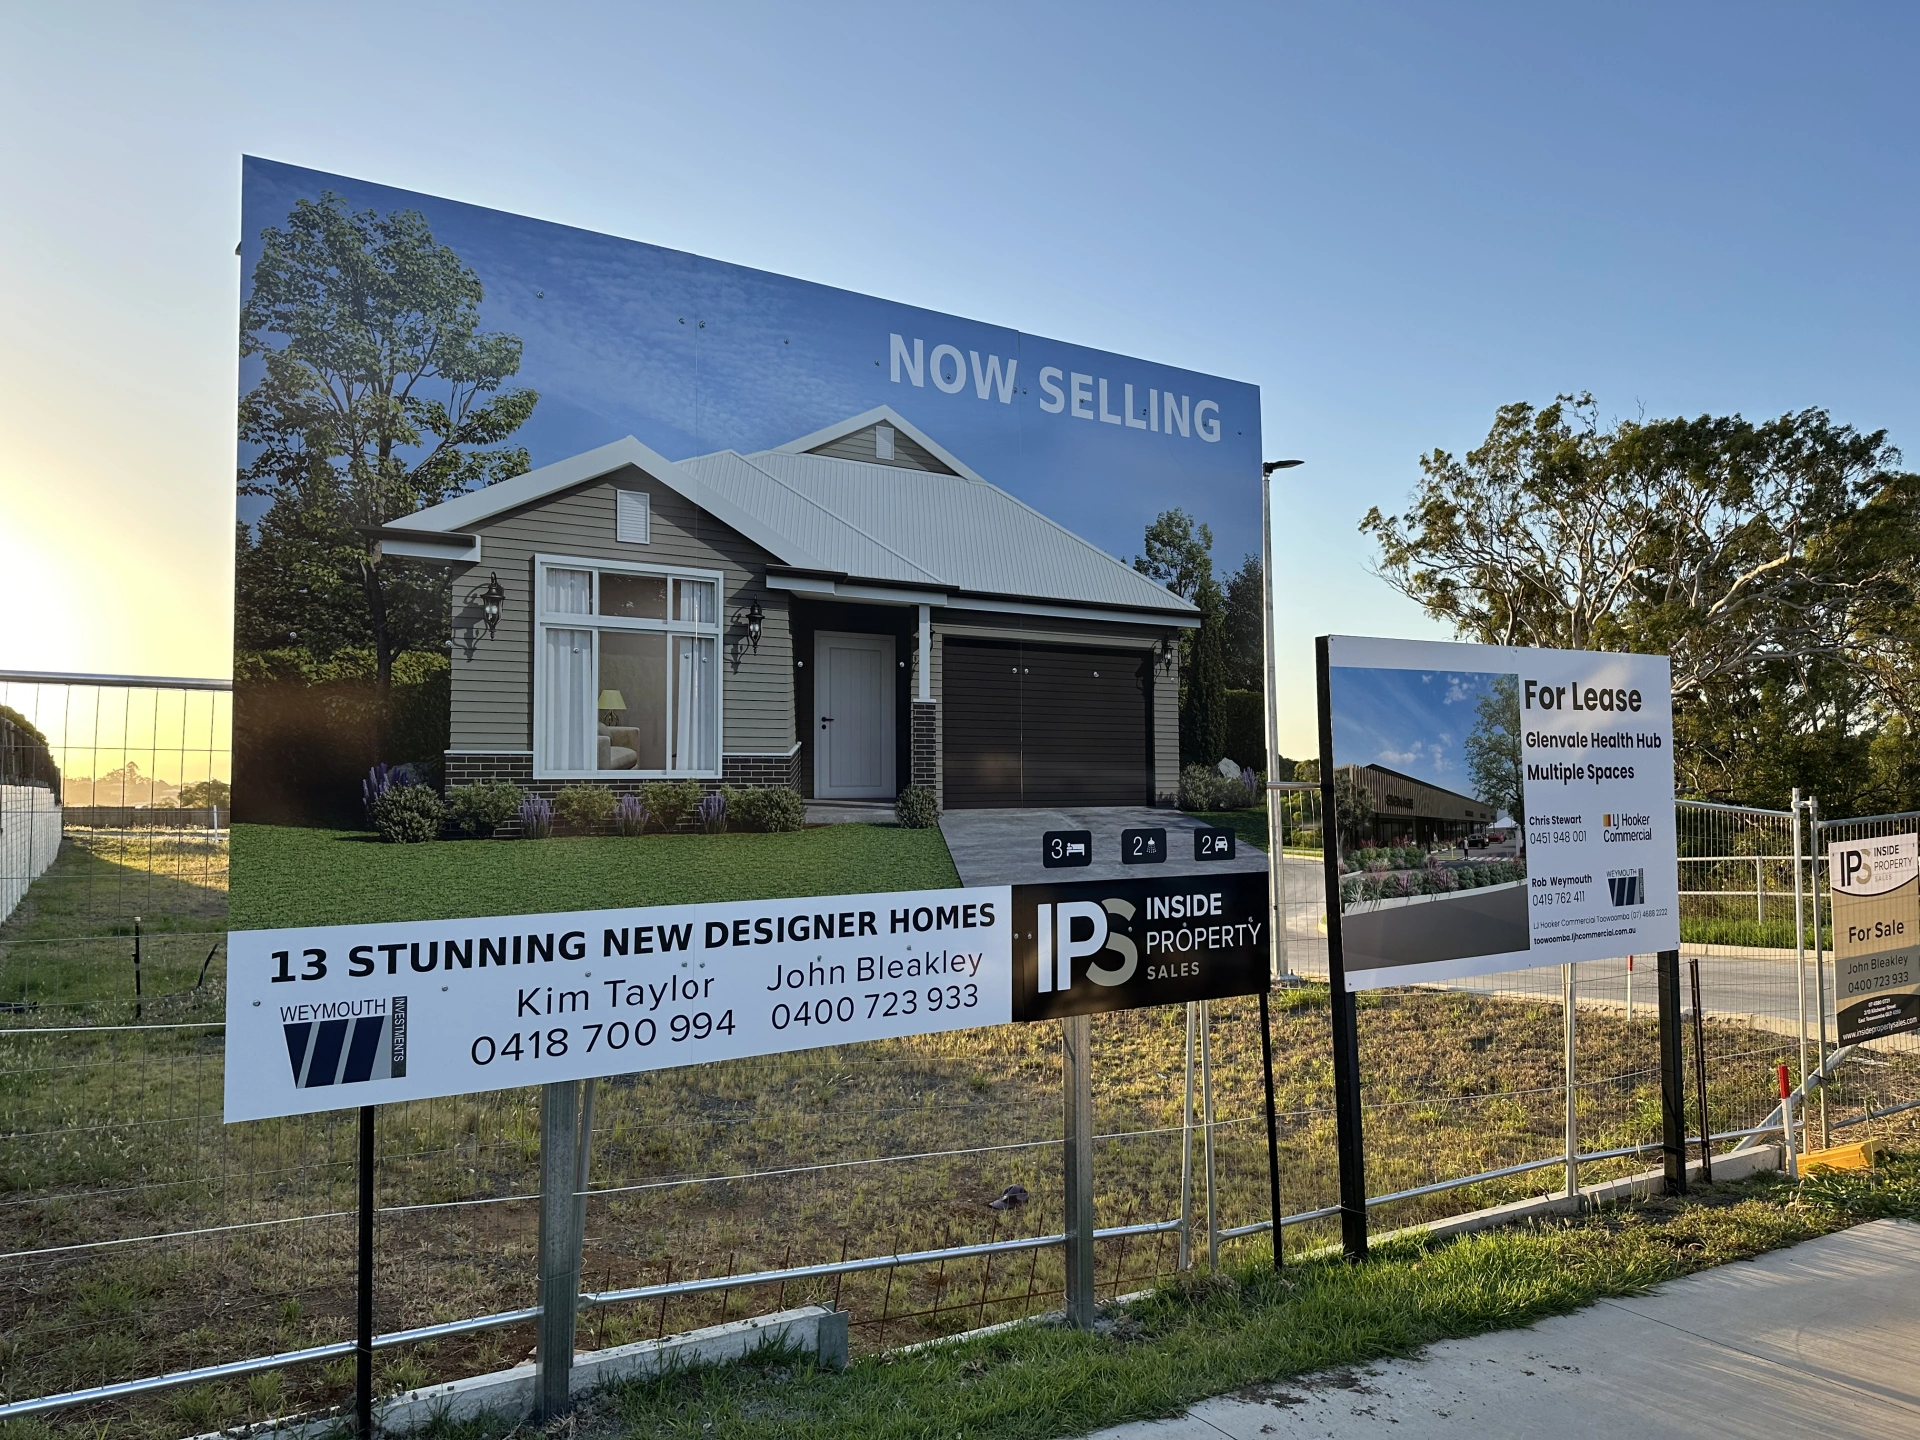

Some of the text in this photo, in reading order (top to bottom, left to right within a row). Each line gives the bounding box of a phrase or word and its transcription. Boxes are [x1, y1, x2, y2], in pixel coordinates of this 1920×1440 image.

[889, 332, 1222, 443] NOW SELLING
[1524, 679, 1642, 712] For Lease
[1525, 731, 1662, 748] Glenvale Health Hub
[1527, 762, 1635, 785] Multiple Spaces
[1529, 814, 1582, 826] Chris Stewart
[1612, 813, 1651, 830] LJ Hooker
[1132, 835, 1144, 857] 2
[1201, 834, 1212, 855] 2
[1530, 830, 1587, 844] 0451 948 001
[1603, 827, 1652, 843] Commercial
[1050, 838, 1063, 860] 3
[1873, 844, 1899, 858] INSIDE
[1606, 868, 1637, 877] WEYMOUTH
[1840, 848, 1872, 887] IPS
[1873, 856, 1913, 871] PROPERTY
[1532, 874, 1593, 889] Rob Weymouth
[1874, 873, 1893, 883] SALES
[1146, 893, 1222, 920] INSIDE
[1532, 890, 1585, 906] 0419 762 411
[1540, 918, 1560, 929] Hooker
[1561, 915, 1596, 927] Commercial
[1596, 912, 1630, 923] Toowoomba
[1630, 909, 1642, 920] (07)
[1146, 922, 1262, 954] PROPERTY
[1848, 919, 1905, 944] For Sale
[270, 902, 996, 984] 13 STUNNING NEW DESIGNER HOMES
[1037, 897, 1138, 994] IPS
[767, 948, 983, 992] John Bleakley
[1147, 961, 1200, 980] SALES
[1848, 954, 1908, 975] John Bleakley
[1848, 971, 1909, 993] 0400 723 933
[518, 974, 714, 1018] Kim Taylor
[772, 983, 979, 1030] 0400 723 933
[280, 998, 387, 1023] WEYMOUTH
[393, 997, 406, 1062] INVESTMENTS
[471, 1009, 736, 1066] 0418 700 994
[1842, 1016, 1918, 1040] www.insidepropertysales.com
